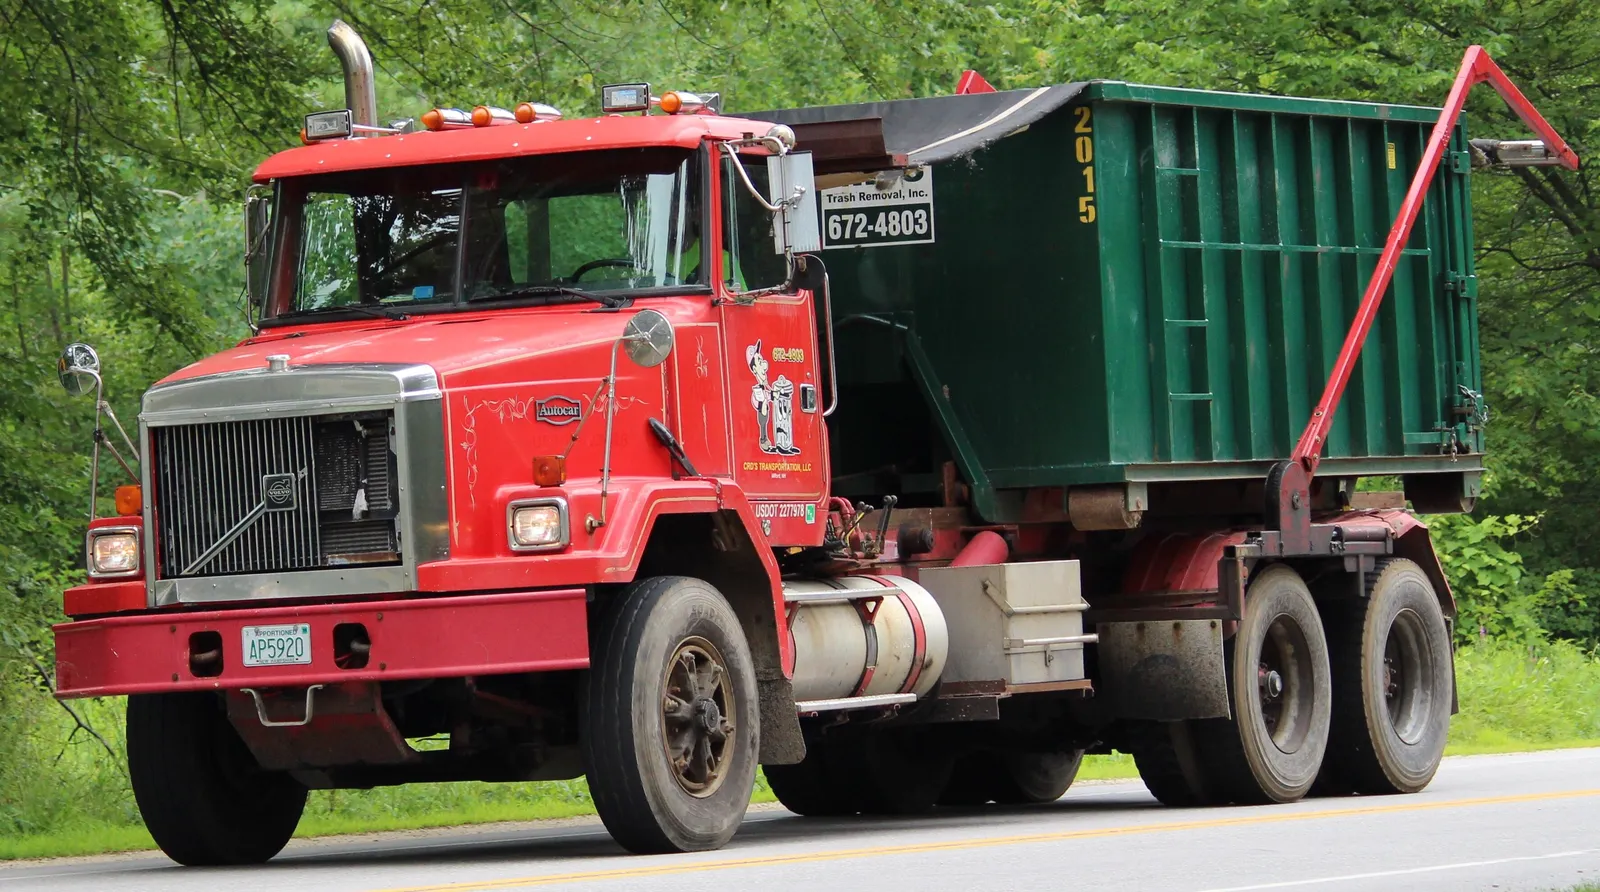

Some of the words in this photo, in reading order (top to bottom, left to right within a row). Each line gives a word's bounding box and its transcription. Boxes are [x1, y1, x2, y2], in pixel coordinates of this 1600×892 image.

[1074, 106, 1096, 223] 2015
[826, 194, 856, 203] Trash
[859, 190, 905, 201] Removal,
[908, 189, 928, 198] Inc.
[828, 209, 928, 240] 672-4803
[540, 404, 578, 415] Autocar
[802, 463, 812, 471] LLC
[755, 503, 779, 518] USDOT
[779, 503, 805, 518] 2277978
[250, 637, 303, 659] AP5920
